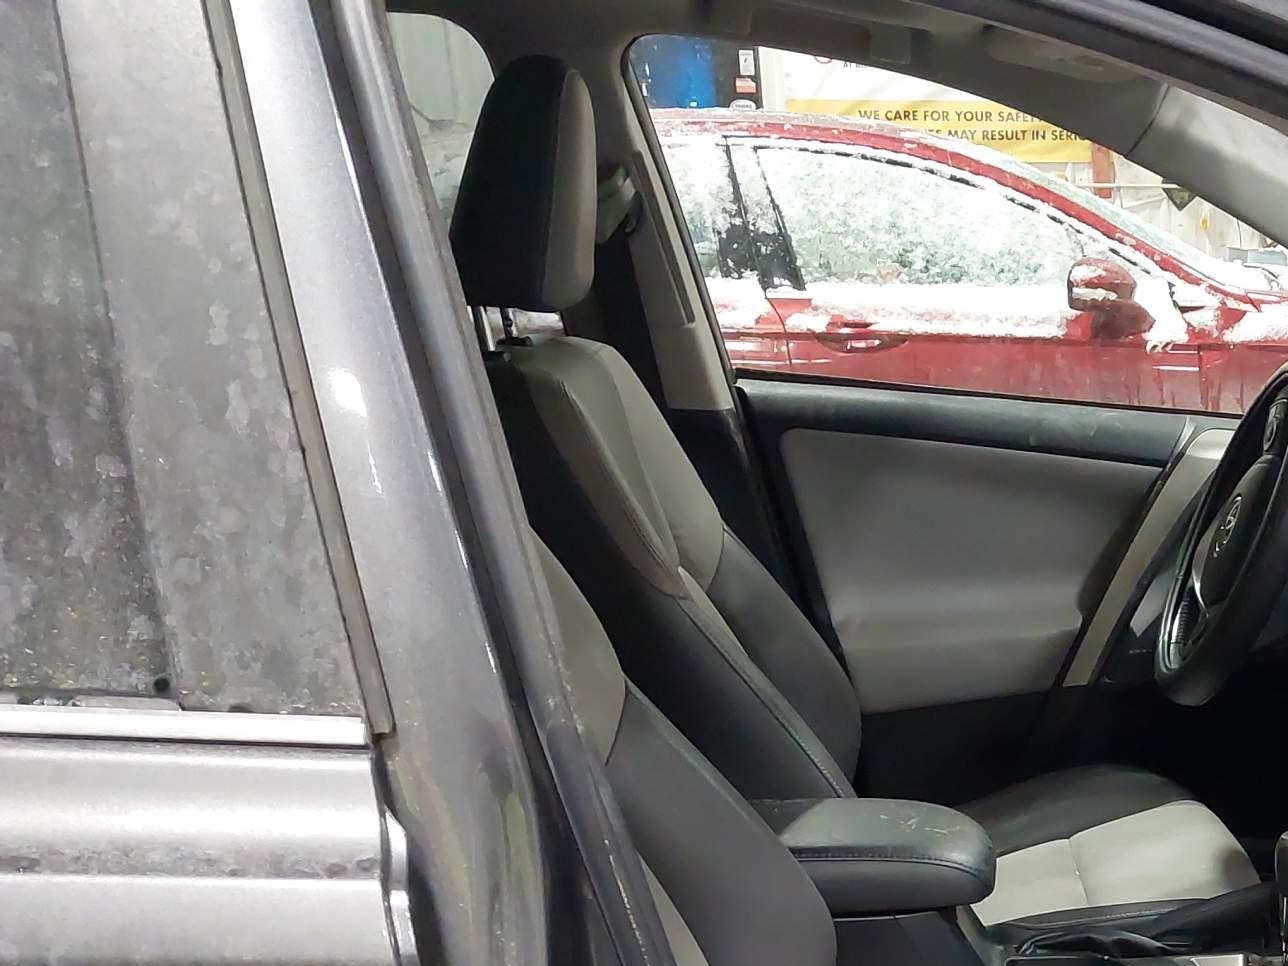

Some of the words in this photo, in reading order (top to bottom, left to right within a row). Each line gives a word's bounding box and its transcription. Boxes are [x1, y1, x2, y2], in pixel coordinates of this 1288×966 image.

[858, 110, 880, 121] WE
[884, 110, 918, 122] CARE
[924, 110, 950, 122] FOR
[955, 110, 993, 122] YOUR
[998, 111, 1043, 123] SAFE
[947, 130, 977, 142] MAY
[982, 130, 1028, 142] RESULT
[1031, 130, 1046, 141] IN
[1051, 130, 1083, 142] SERI
